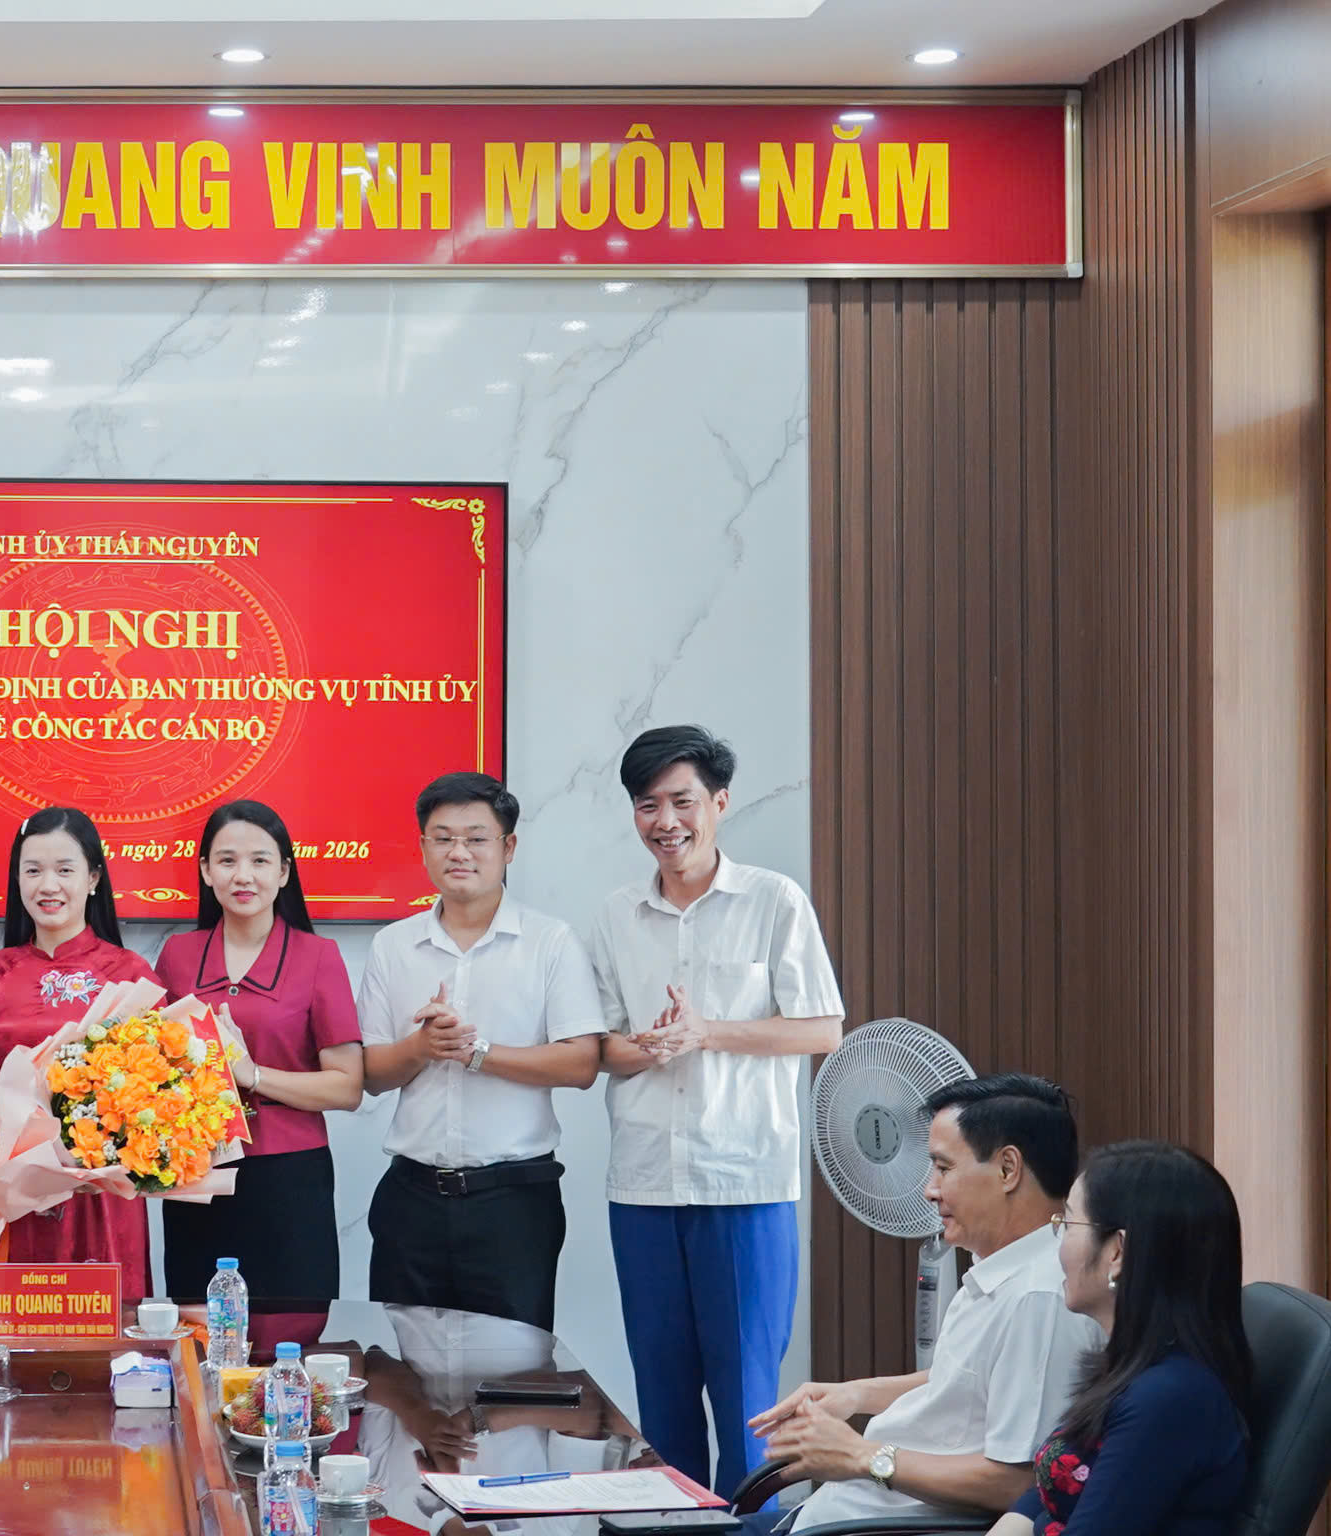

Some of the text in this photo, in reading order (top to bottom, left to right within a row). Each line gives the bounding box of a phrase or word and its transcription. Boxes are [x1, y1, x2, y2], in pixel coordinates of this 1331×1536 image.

[263, 141, 452, 231] VINH
[485, 123, 725, 230] MUÔN
[758, 123, 950, 230] NĂM
[34, 529, 71, 557] ỦY
[75, 530, 143, 556] THÁI
[147, 531, 259, 558] NGUYÊN
[103, 609, 242, 661] NGHỊ
[66, 671, 128, 700] CỦA
[129, 678, 187, 701] BAN
[192, 672, 315, 702] THƯỜNG
[319, 679, 361, 707] VỤ
[363, 674, 433, 702] TỈNH
[438, 674, 480, 702] ỦY
[12, 710, 94, 740] CÔNG
[99, 711, 157, 740] TÁC
[161, 711, 222, 741] CÁN
[226, 713, 266, 747] BỘ
[121, 839, 168, 862] ngày
[172, 839, 196, 858] 28
[291, 841, 318, 859] ăm
[323, 840, 370, 859] 2026
[15, 1294, 63, 1316] QUANG
[67, 1291, 112, 1314] TUYÊN
